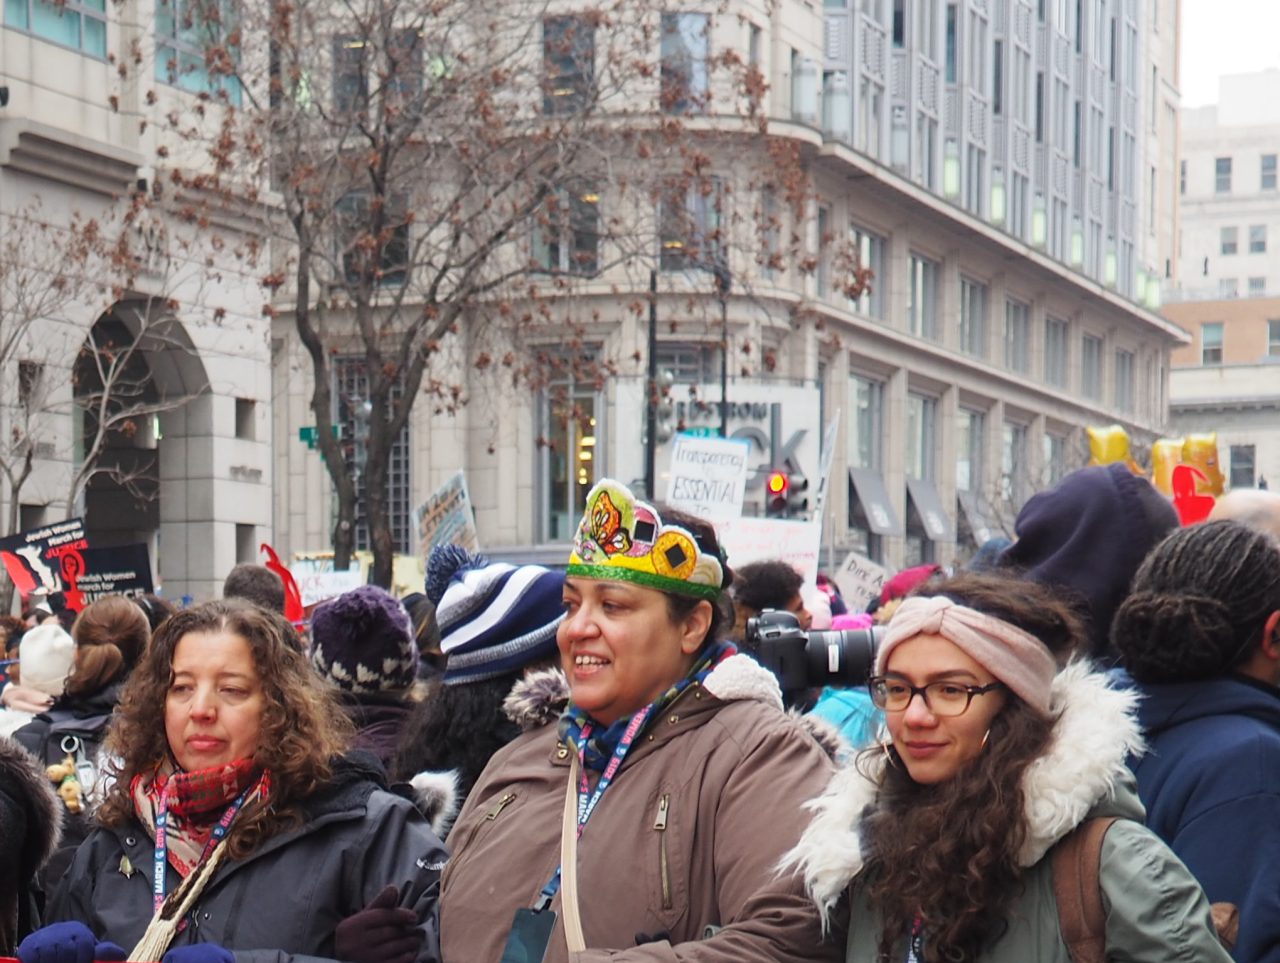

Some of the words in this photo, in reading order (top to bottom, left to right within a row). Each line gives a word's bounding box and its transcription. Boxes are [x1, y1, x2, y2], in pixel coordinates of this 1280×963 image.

[672, 476, 738, 505] ESSENTIAL
[25, 528, 53, 543] Jewish
[52, 521, 82, 535] Women
[48, 534, 72, 547] March
[71, 530, 85, 540] for
[101, 582, 115, 591] for
[103, 571, 136, 582] Women
[80, 588, 145, 606] JUCE
[603, 757, 621, 780] 2019
[220, 807, 237, 828] 2019
[156, 827, 165, 849] 2019
[154, 861, 164, 894] MARCH
